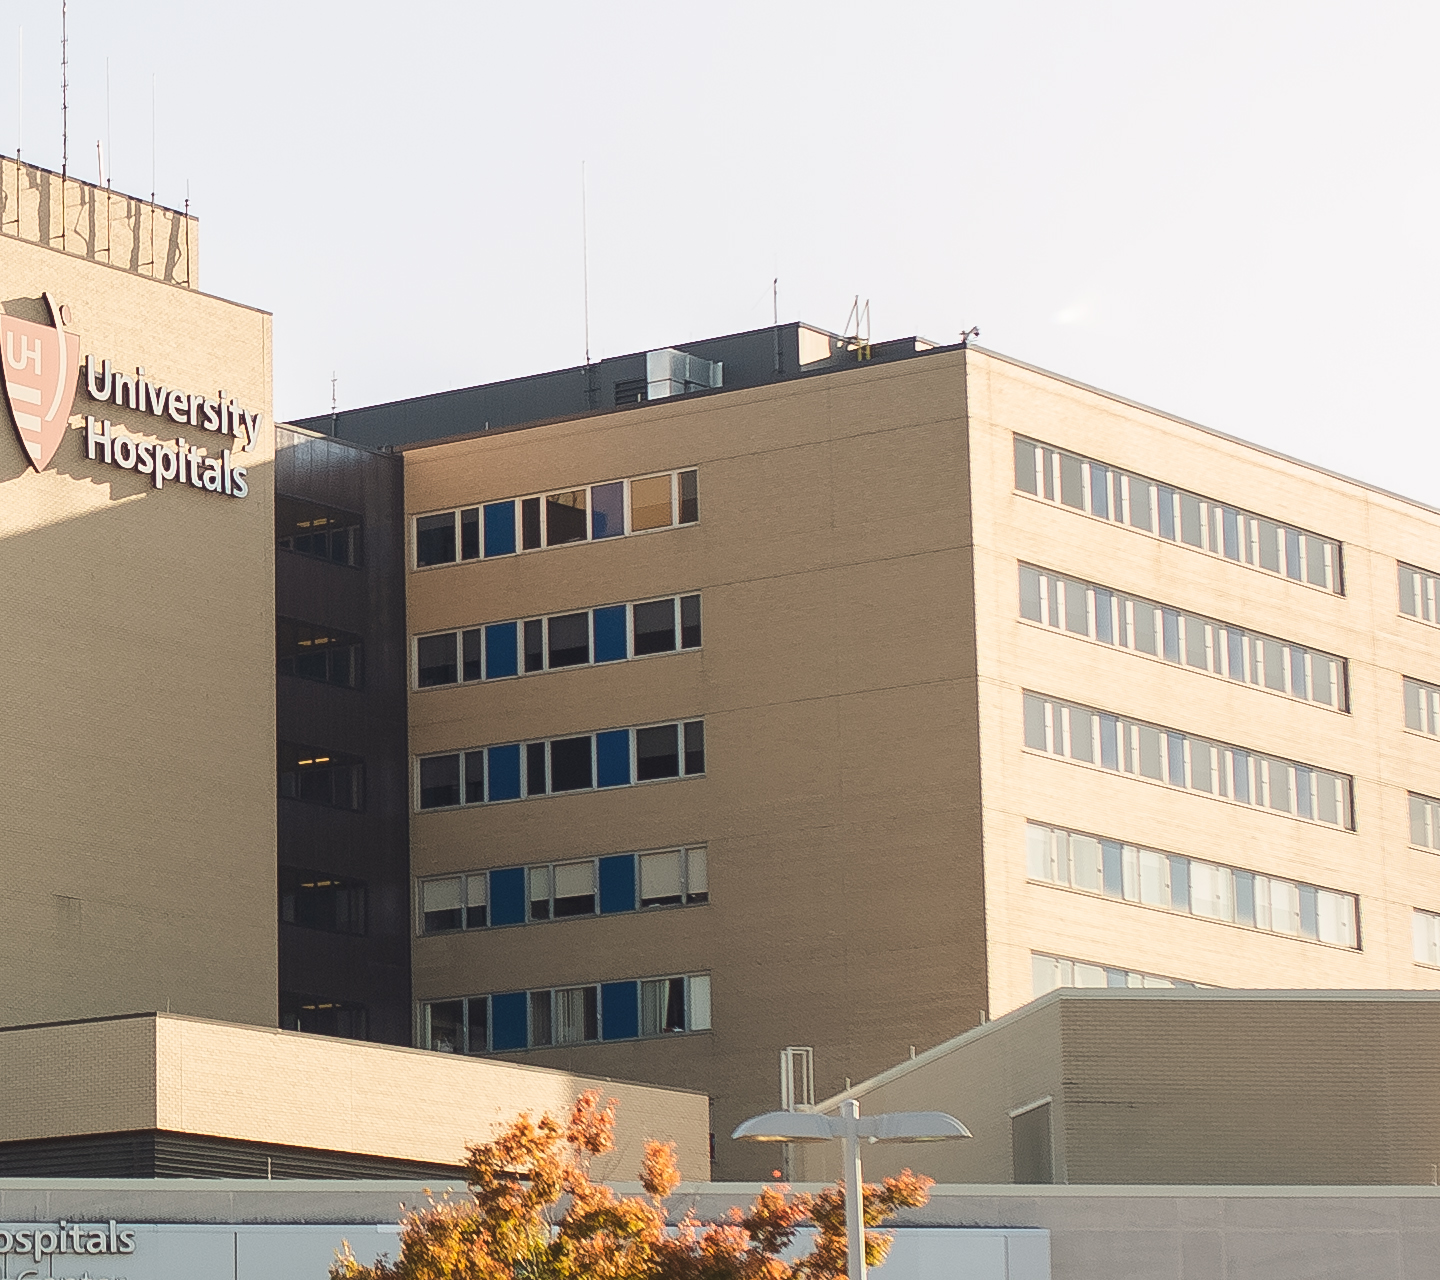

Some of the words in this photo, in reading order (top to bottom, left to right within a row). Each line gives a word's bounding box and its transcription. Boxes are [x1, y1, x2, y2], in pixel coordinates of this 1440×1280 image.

[6, 330, 42, 376] UH
[84, 352, 262, 453] University
[84, 414, 249, 499] Hospitals
